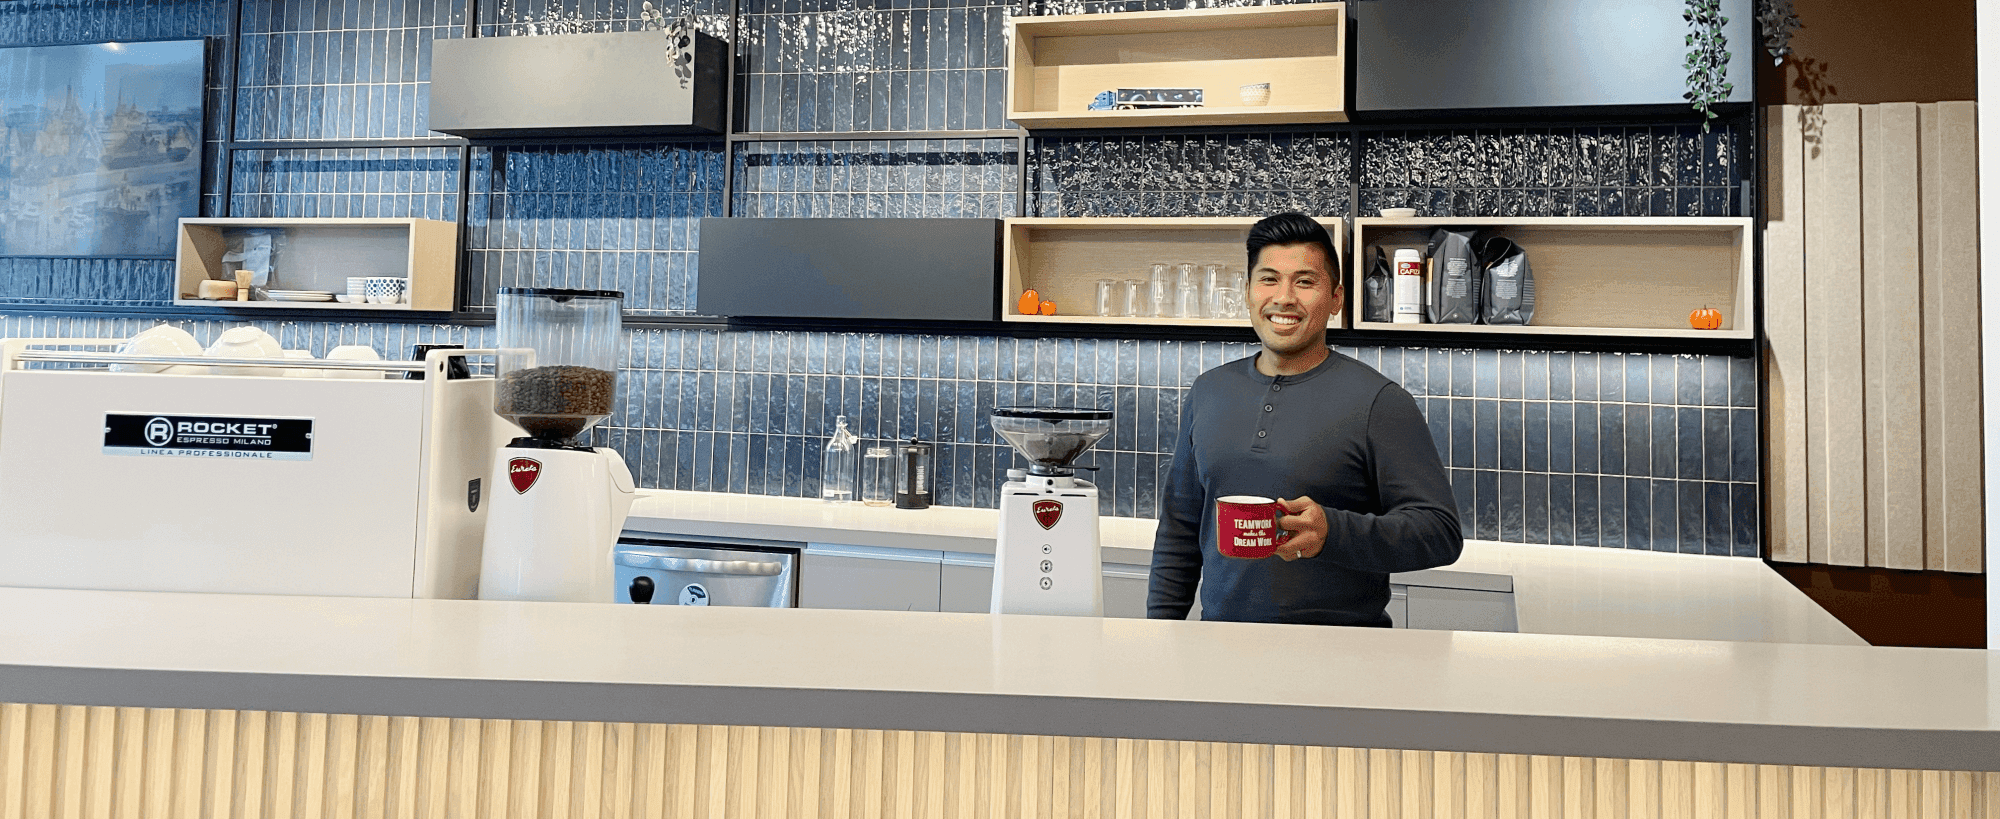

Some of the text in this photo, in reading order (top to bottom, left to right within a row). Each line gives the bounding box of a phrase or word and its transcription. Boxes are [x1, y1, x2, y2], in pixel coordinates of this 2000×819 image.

[176, 436, 272, 446] ESPRESSO MILANO
[178, 449, 273, 459] PROFESSIONALE
[1234, 519, 1272, 529] TEAMWORK
